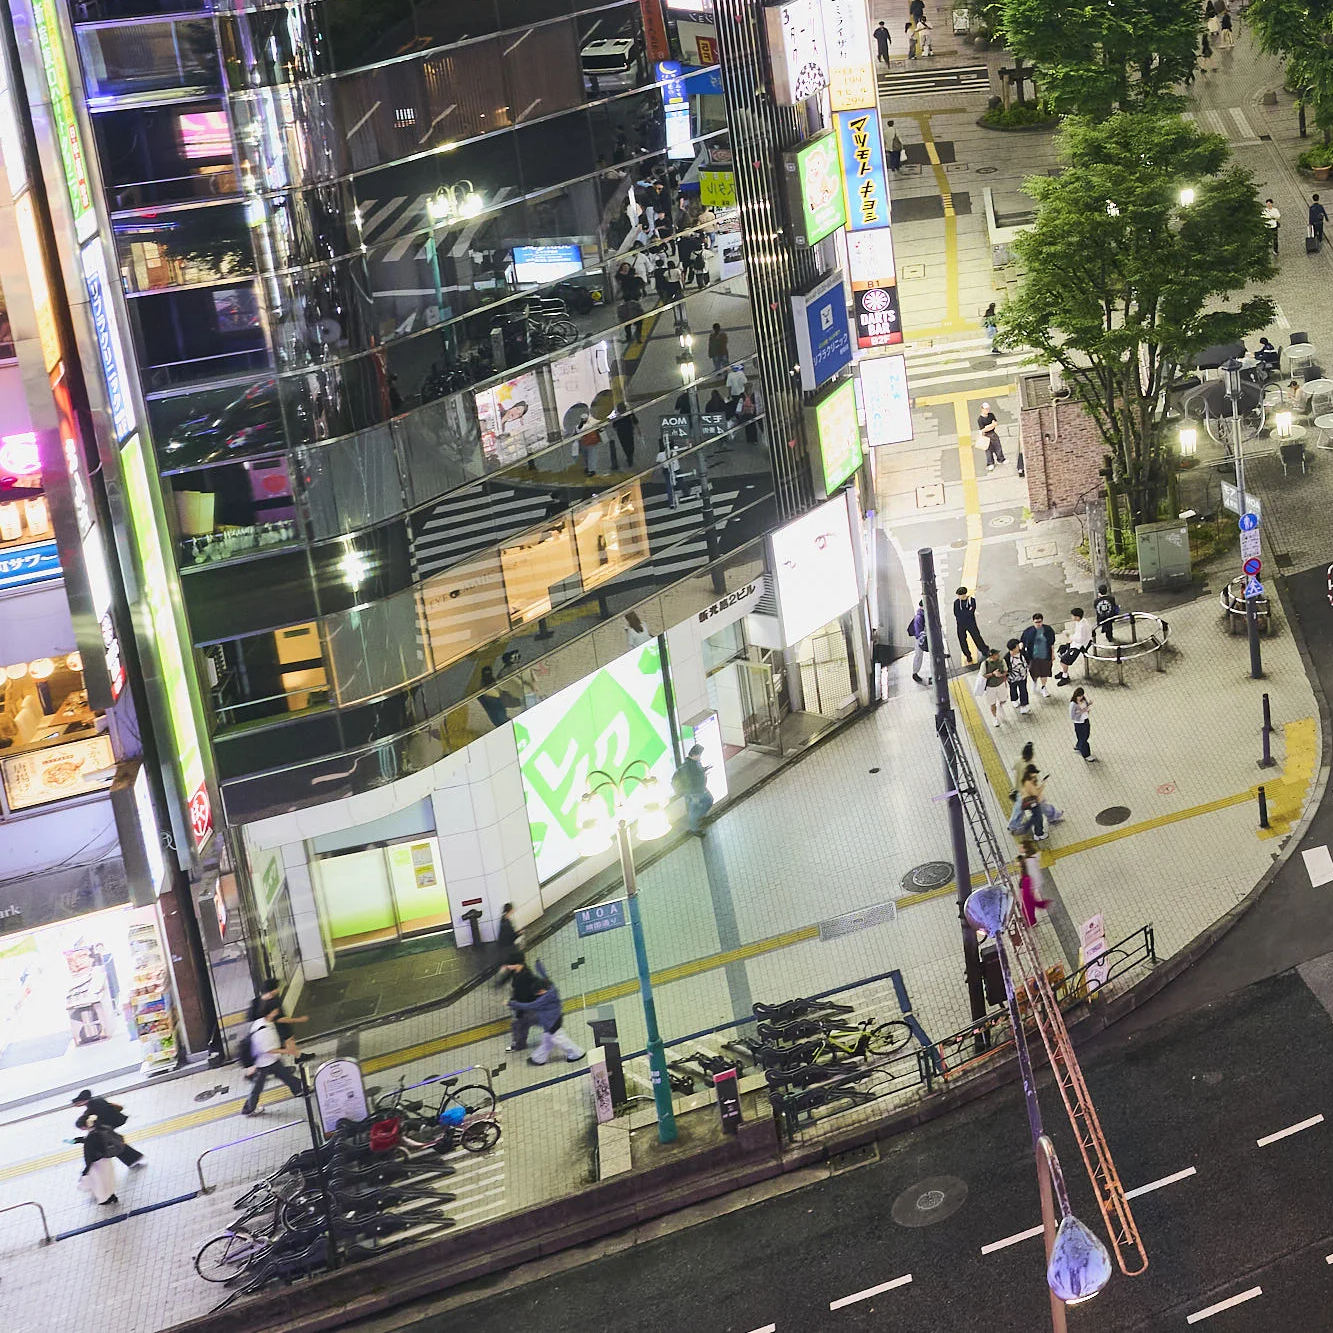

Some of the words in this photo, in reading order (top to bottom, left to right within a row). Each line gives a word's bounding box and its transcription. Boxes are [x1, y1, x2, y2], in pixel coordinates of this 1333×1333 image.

[867, 279, 882, 289] B1
[859, 309, 897, 326] DARTS
[867, 321, 891, 337] BAR
[870, 335, 891, 347] B2F
[580, 903, 619, 922] MOA
